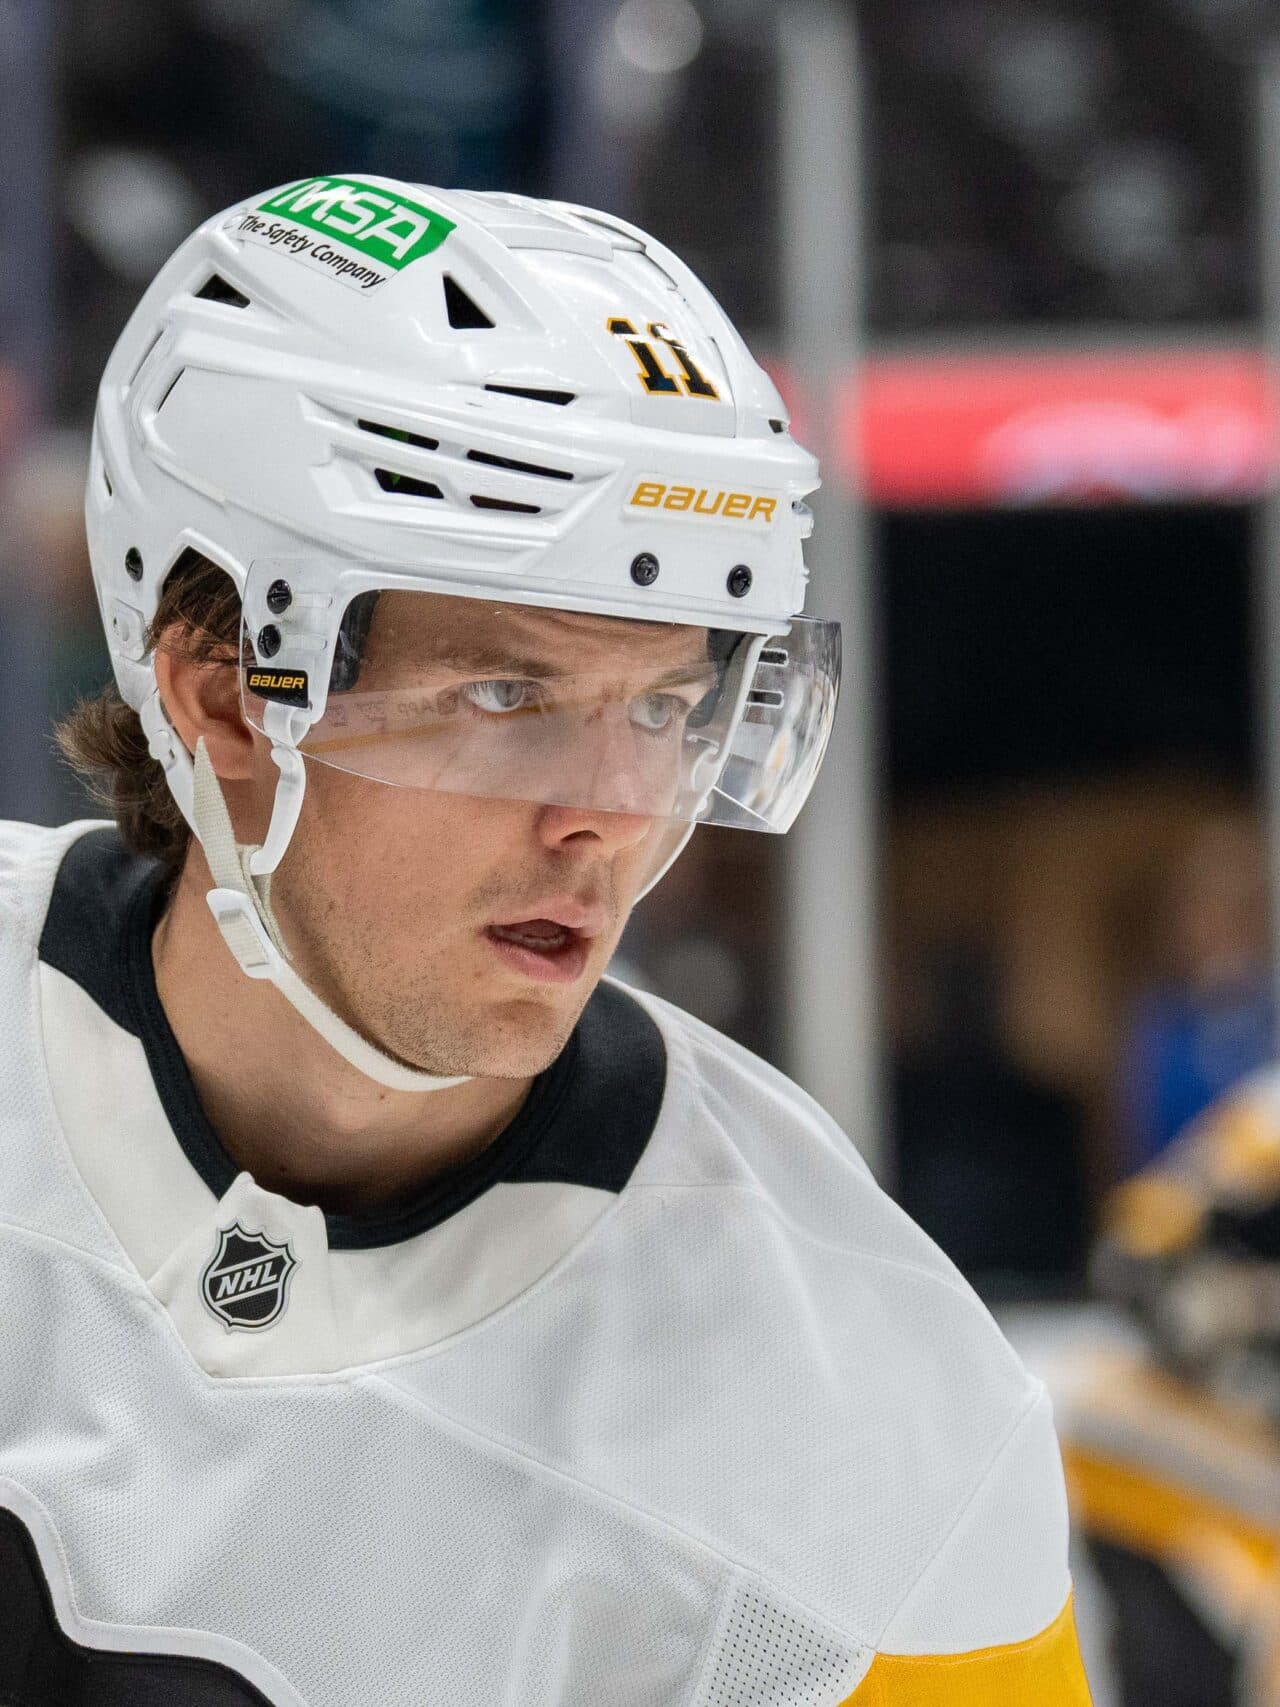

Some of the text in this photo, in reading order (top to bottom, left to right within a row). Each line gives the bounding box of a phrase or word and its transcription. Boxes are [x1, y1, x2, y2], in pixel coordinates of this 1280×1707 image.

[238, 214, 387, 289] The Safety Company
[271, 180, 432, 262] MSA
[606, 317, 721, 402] 11
[215, 1260, 279, 1300] NHL
